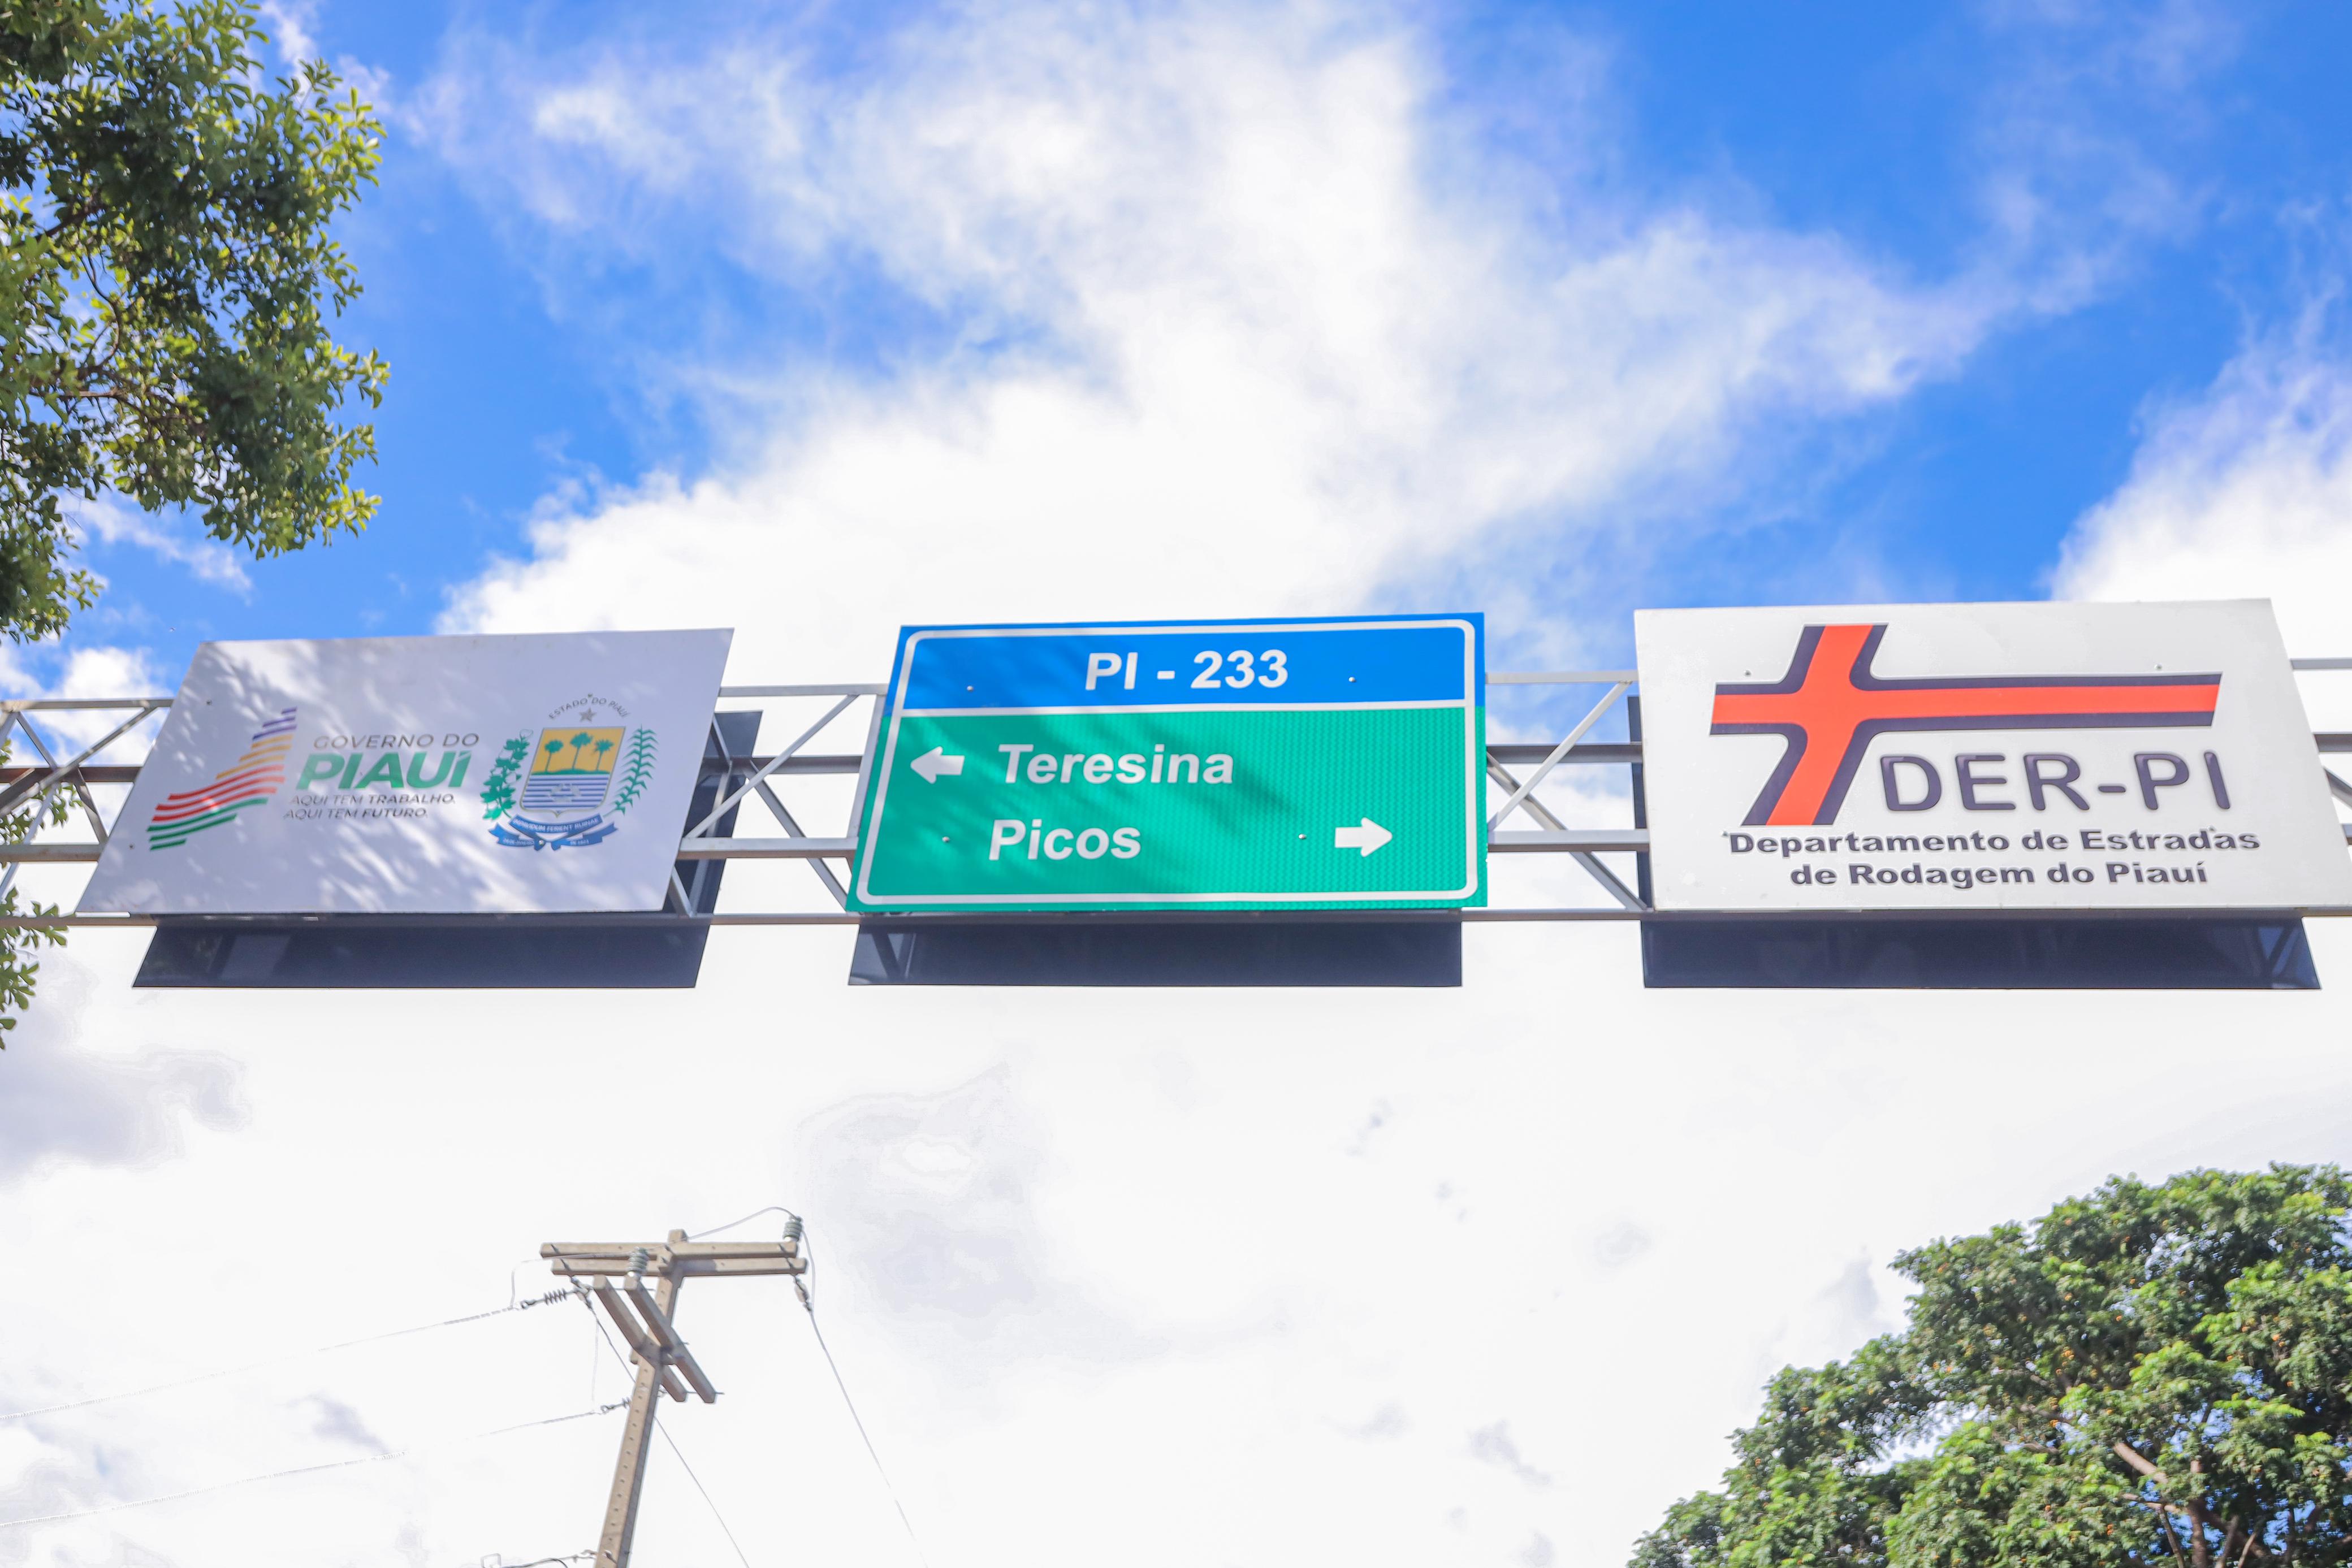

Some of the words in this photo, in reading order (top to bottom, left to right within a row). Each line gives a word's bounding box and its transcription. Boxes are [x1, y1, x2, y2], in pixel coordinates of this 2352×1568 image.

[1084, 651, 1139, 691] PI
[1190, 649, 1289, 689] 233
[548, 698, 588, 719] ESTADO
[591, 696, 607, 705] DO
[313, 734, 434, 750] GOVERNO
[442, 733, 479, 748] DO
[295, 750, 472, 791] PIAUÍ
[998, 743, 1234, 785] Teresina
[1879, 751, 2232, 813] DER-PI
[284, 808, 323, 820] AQUI
[327, 808, 357, 818] TEM
[289, 794, 328, 807] AQUI
[333, 794, 364, 804] TEM
[368, 792, 456, 804] TRABALHO.
[988, 818, 1142, 861] Picos
[1729, 831, 2011, 858] Departamento
[2021, 830, 2069, 851] de
[2079, 829, 2260, 850] Estradas
[1790, 865, 1838, 885] de
[1848, 864, 2036, 890] Rodagem
[2047, 863, 2095, 884] do
[2105, 861, 2208, 883] Piauí
